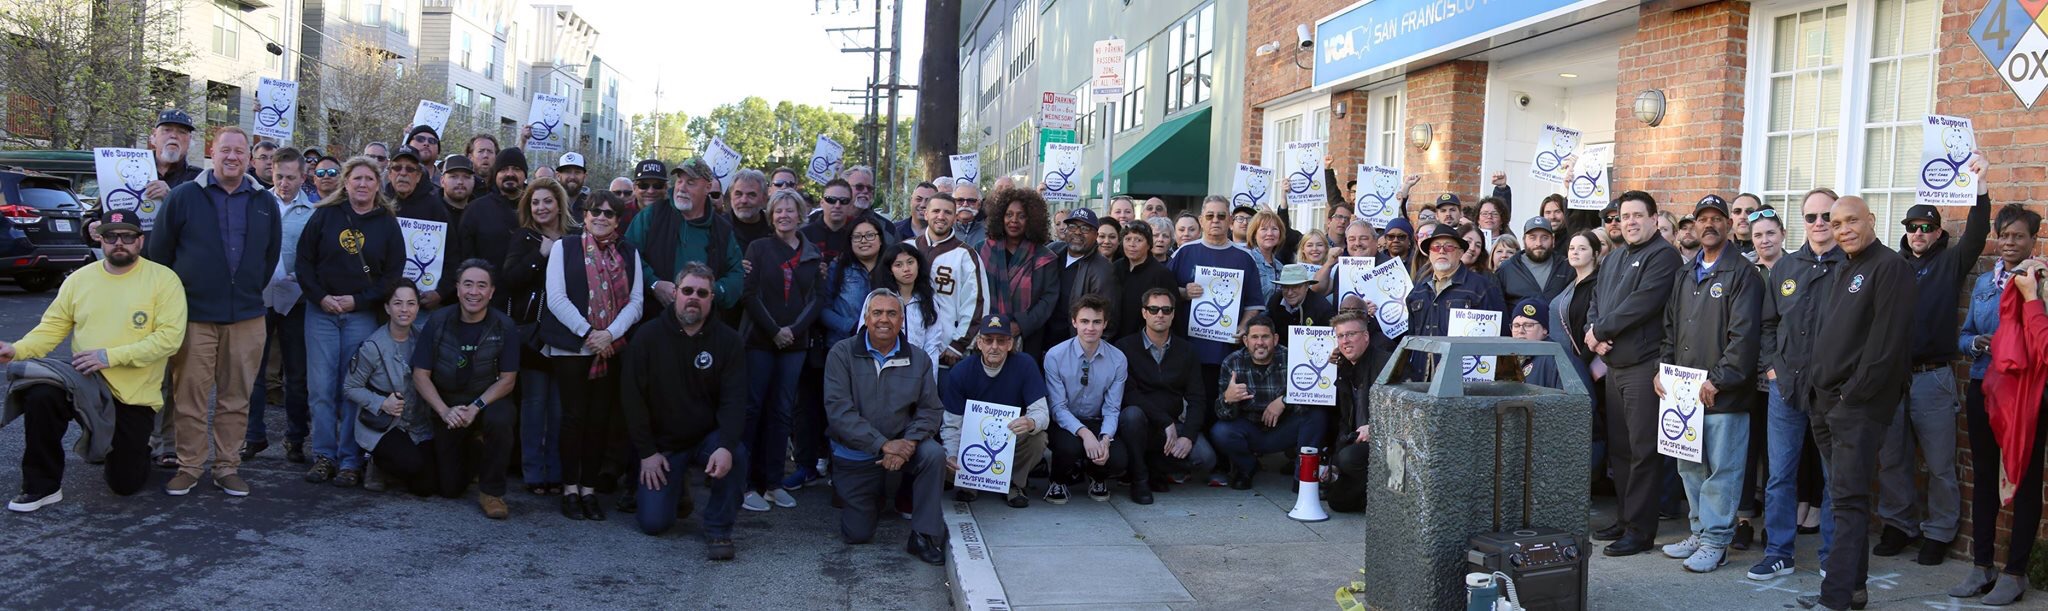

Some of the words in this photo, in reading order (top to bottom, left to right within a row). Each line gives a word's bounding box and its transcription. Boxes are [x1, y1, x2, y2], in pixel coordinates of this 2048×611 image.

[1982, 0, 2010, 50] 4
[1324, 31, 1354, 64] VCA
[1374, 17, 1397, 45] SAN
[1104, 45, 1123, 53] PARKING
[1096, 56, 1121, 64] PASSENGER
[2008, 49, 2048, 82] OX
[272, 80, 295, 88] Support
[545, 96, 565, 104] Support
[1044, 93, 1053, 103] NO
[1054, 96, 1076, 105] PARKING
[429, 102, 449, 112] Support
[1045, 114, 1073, 122] WEDNESDAY
[1928, 116, 1940, 125] We
[1940, 117, 1968, 128] Support
[1546, 124, 1555, 132] We
[1555, 126, 1579, 137] Support
[1297, 141, 1320, 150] Support
[101, 149, 114, 158] We
[115, 150, 148, 158] Support
[720, 144, 739, 160] Support
[1249, 166, 1271, 175] Support
[1375, 166, 1398, 176] Support
[401, 219, 412, 229] We
[413, 221, 442, 232] Support
[1351, 259, 1372, 267] Support
[1201, 267, 1212, 276] We
[1212, 269, 1240, 279] Support
[1361, 273, 1373, 282] We
[1372, 260, 1399, 277] Support
[1455, 310, 1466, 319] We
[1467, 311, 1497, 322] Support
[1294, 327, 1305, 336] We
[1305, 327, 1335, 338] Support
[1664, 365, 1674, 376] We
[1674, 367, 1702, 381] Support
[971, 403, 983, 414] We
[984, 405, 1015, 418] Support
[1680, 443, 1699, 454] Workers
[985, 477, 1007, 486] Workers
